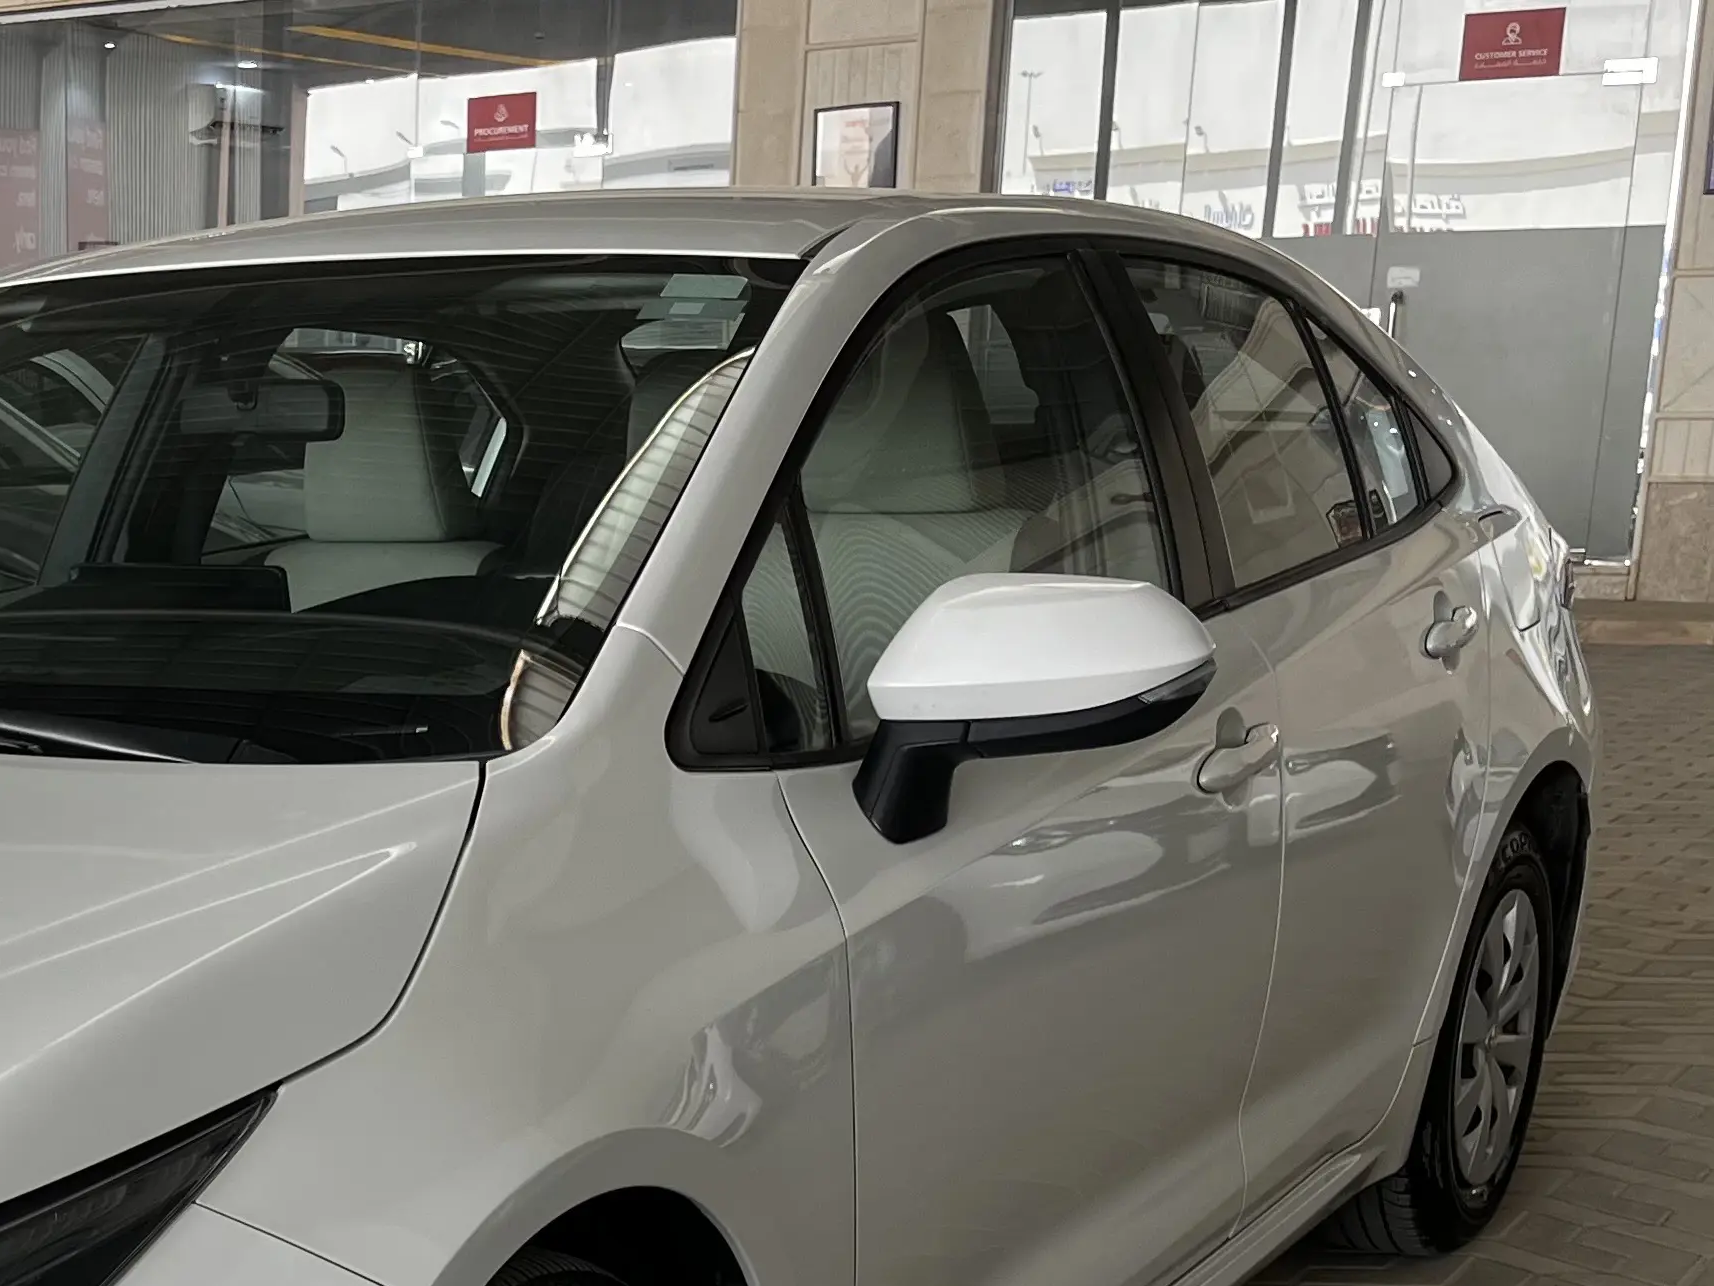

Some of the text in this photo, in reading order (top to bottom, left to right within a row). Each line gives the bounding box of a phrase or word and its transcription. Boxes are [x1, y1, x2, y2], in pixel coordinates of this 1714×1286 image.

[1474, 48, 1548, 60] CUSTOMER SERVICE
[474, 124, 529, 137] PROCUREMENT
